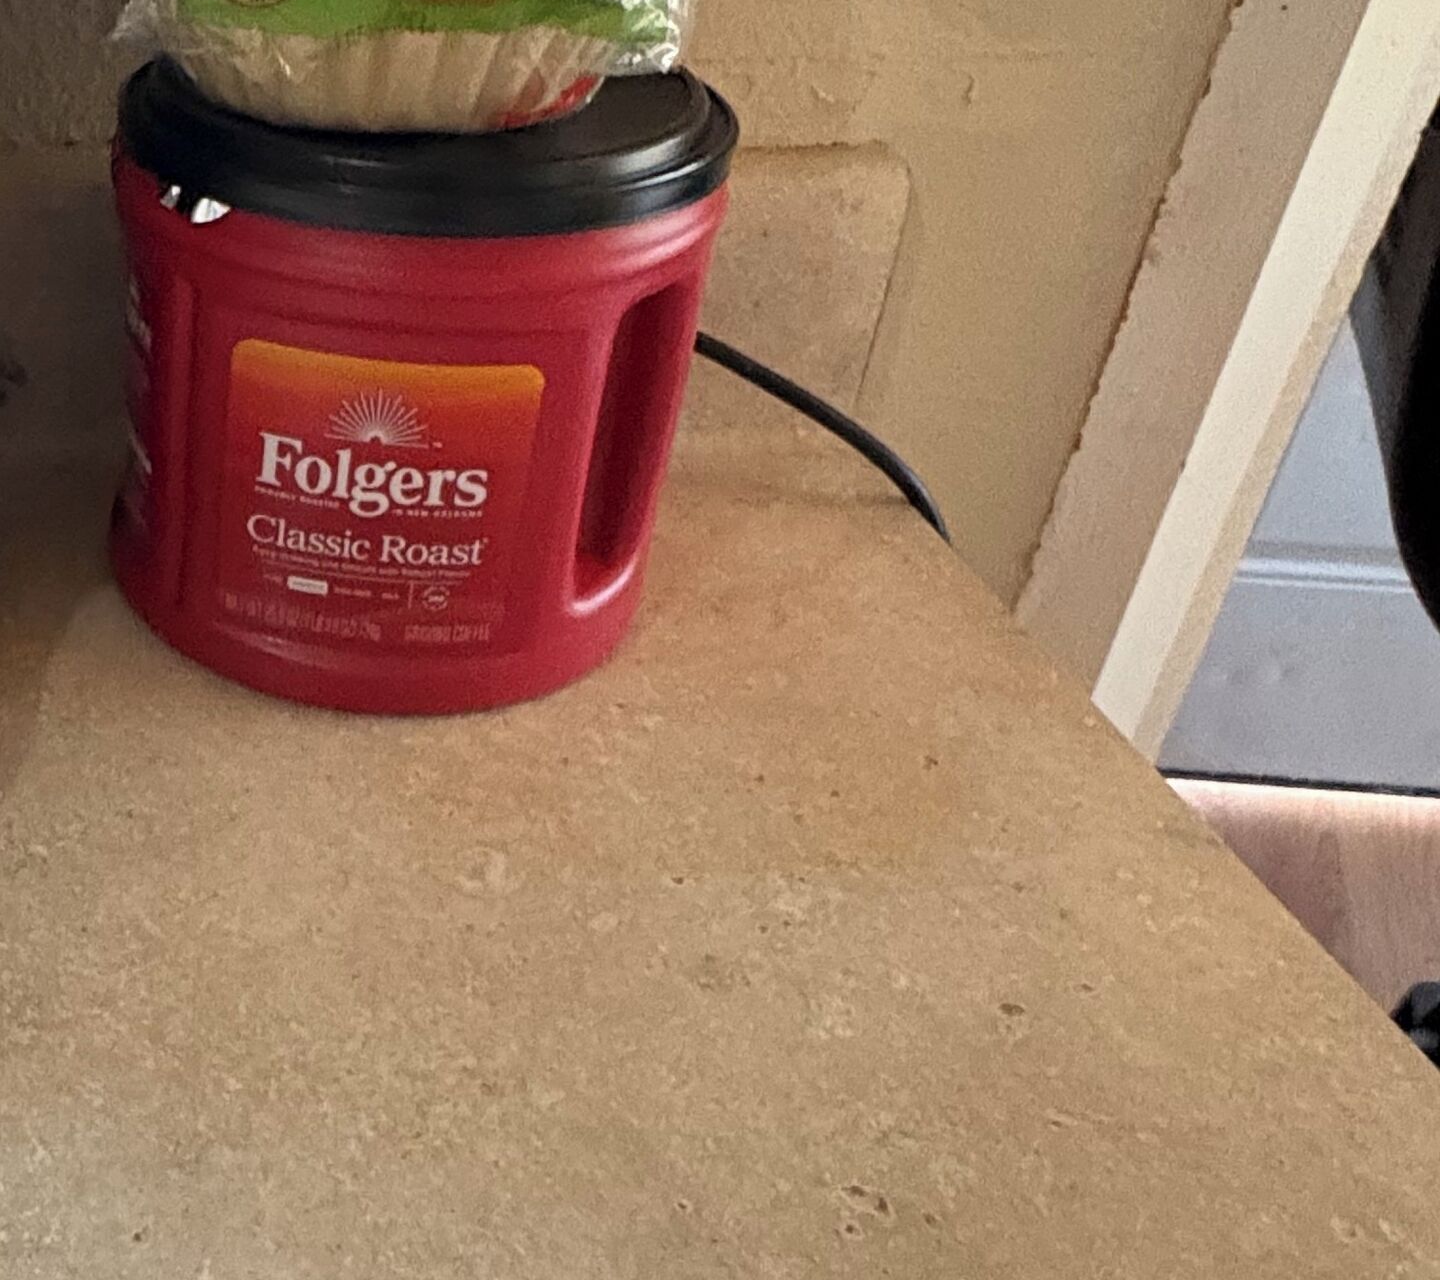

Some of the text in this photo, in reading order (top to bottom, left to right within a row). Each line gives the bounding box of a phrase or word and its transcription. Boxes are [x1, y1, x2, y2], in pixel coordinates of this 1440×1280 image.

[255, 431, 489, 519] Folgers
[246, 514, 371, 562] Classic
[380, 535, 484, 566] Roast
